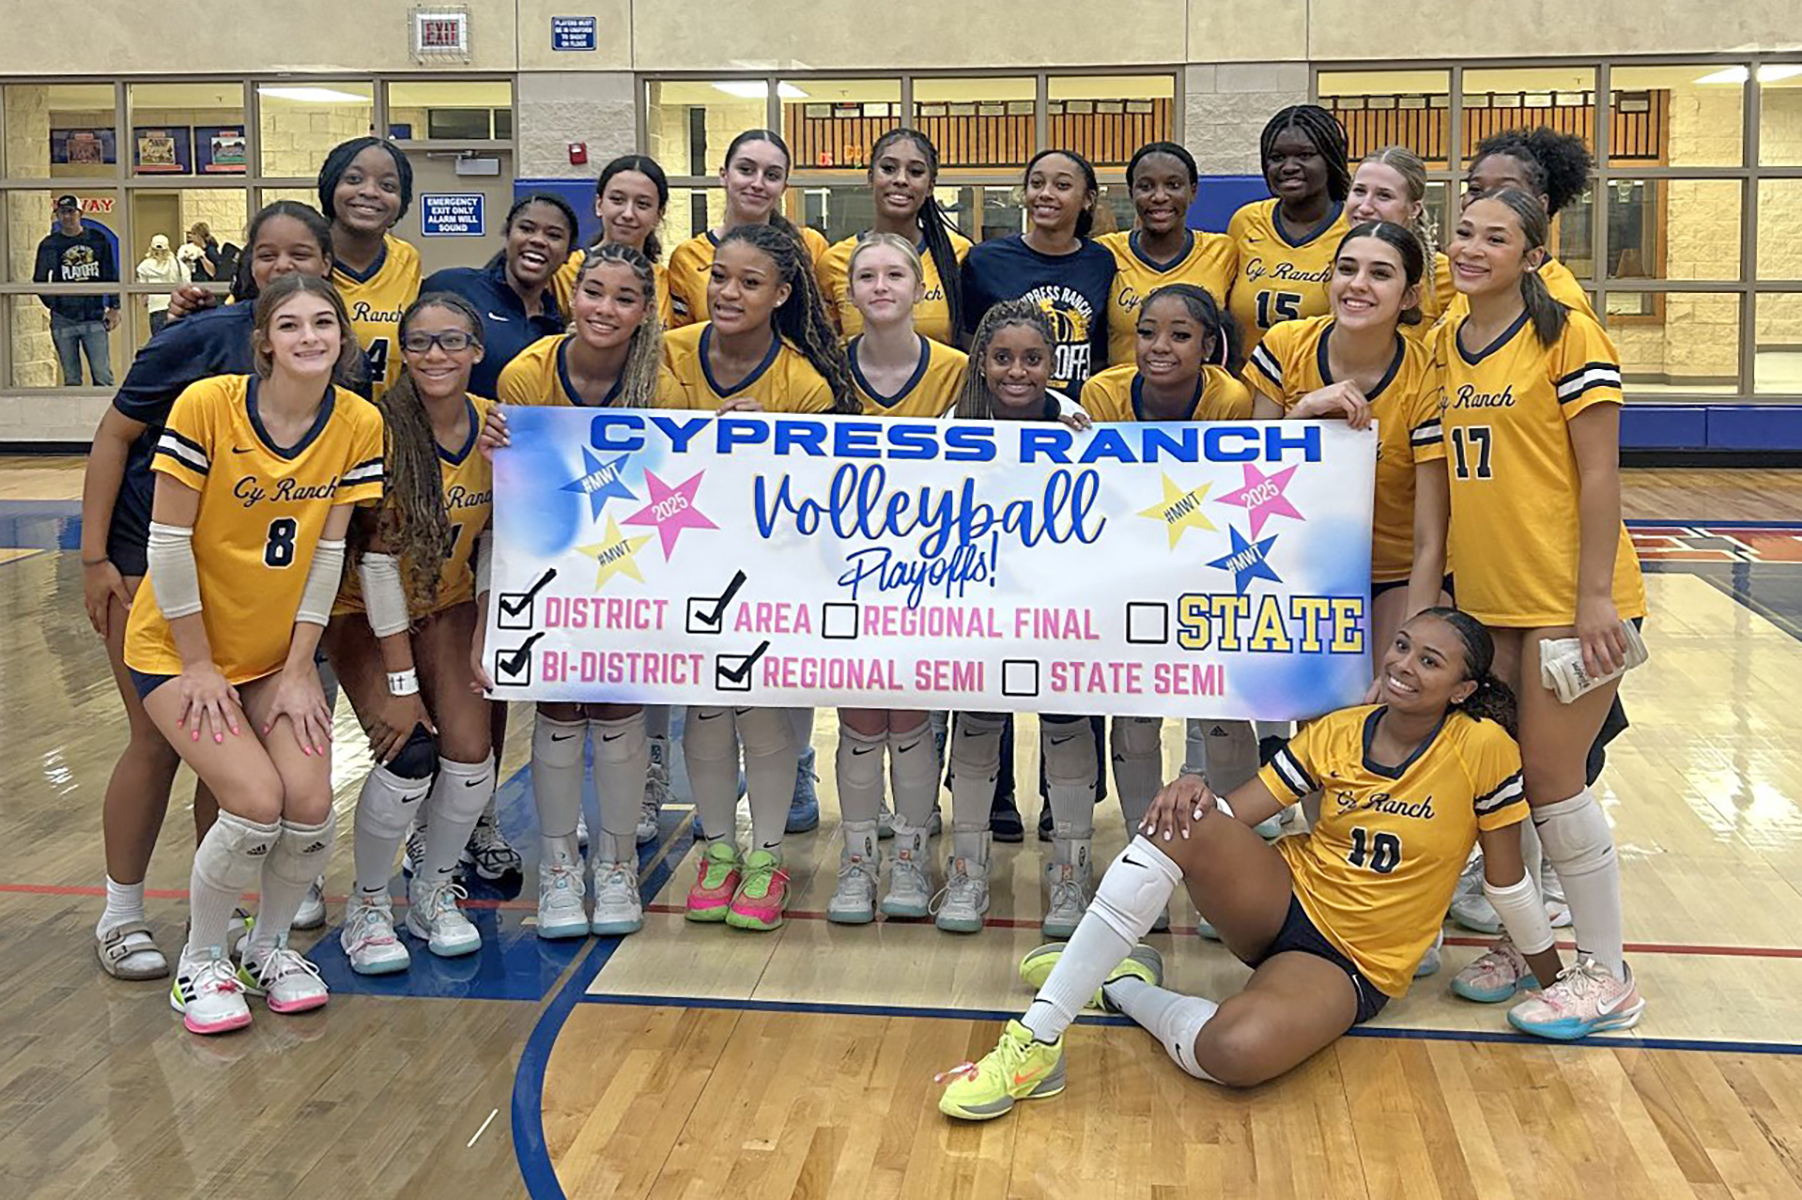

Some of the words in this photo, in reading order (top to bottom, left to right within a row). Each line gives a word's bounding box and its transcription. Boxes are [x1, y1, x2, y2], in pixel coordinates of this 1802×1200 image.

[426, 21, 457, 45] EXIT
[427, 198, 478, 206] EMERGENCY
[428, 215, 456, 223] ALARM
[457, 215, 479, 223] WILL
[439, 224, 468, 232] SOUND
[61, 261, 99, 281] PLAYOFFS
[1246, 258, 1266, 283] Cy
[1269, 262, 1333, 283] Ranch
[1061, 287, 1093, 318] RANCH
[1254, 289, 1302, 330] 15
[366, 336, 389, 385] 4
[1453, 384, 1516, 409] Ranch
[589, 413, 997, 463] CYPRESS
[1020, 425, 1322, 464] RANCH
[1451, 425, 1493, 481] 17
[233, 476, 266, 508] Cy
[269, 475, 338, 502] Ranch
[581, 462, 622, 495] #MWT
[1240, 478, 1281, 511] 2025
[650, 491, 690, 525] 2025
[754, 462, 1107, 559] Volleyball
[1162, 491, 1202, 525] #MWT
[262, 516, 299, 570] 8
[597, 538, 632, 567] #MWT
[1224, 542, 1265, 576] #MWT
[837, 530, 999, 610] Playoffs!
[545, 596, 669, 631] DISTRICT
[733, 601, 813, 635] AREA
[862, 604, 1003, 639] REGIONAL
[1014, 607, 1100, 641] FINAL
[1177, 592, 1365, 654] STATE
[541, 650, 705, 685] BI-DISTRICT
[762, 655, 903, 691] REGIONAL
[914, 659, 985, 693] SEMI
[1050, 660, 1143, 694] STATE
[1154, 662, 1225, 697] SEMI
[1360, 793, 1435, 820] Ranch
[1347, 825, 1403, 874] 10
